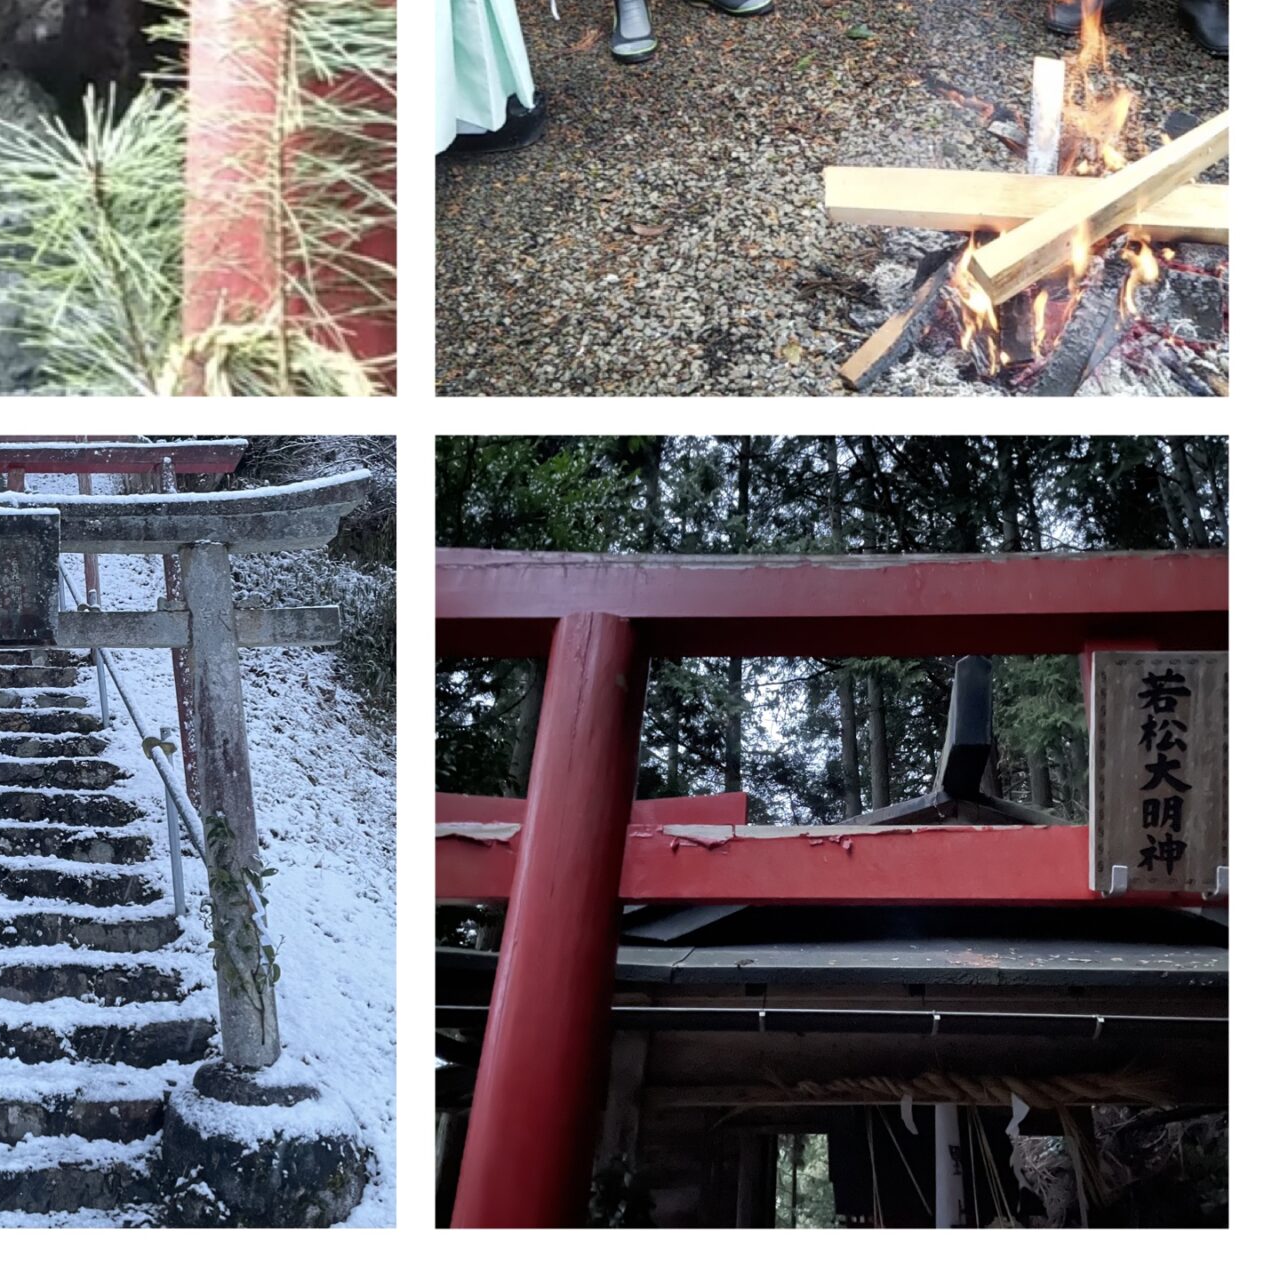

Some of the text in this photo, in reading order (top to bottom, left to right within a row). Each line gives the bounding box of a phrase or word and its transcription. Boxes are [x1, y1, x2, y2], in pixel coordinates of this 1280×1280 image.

[1137, 668, 1192, 875] 若松大明神
